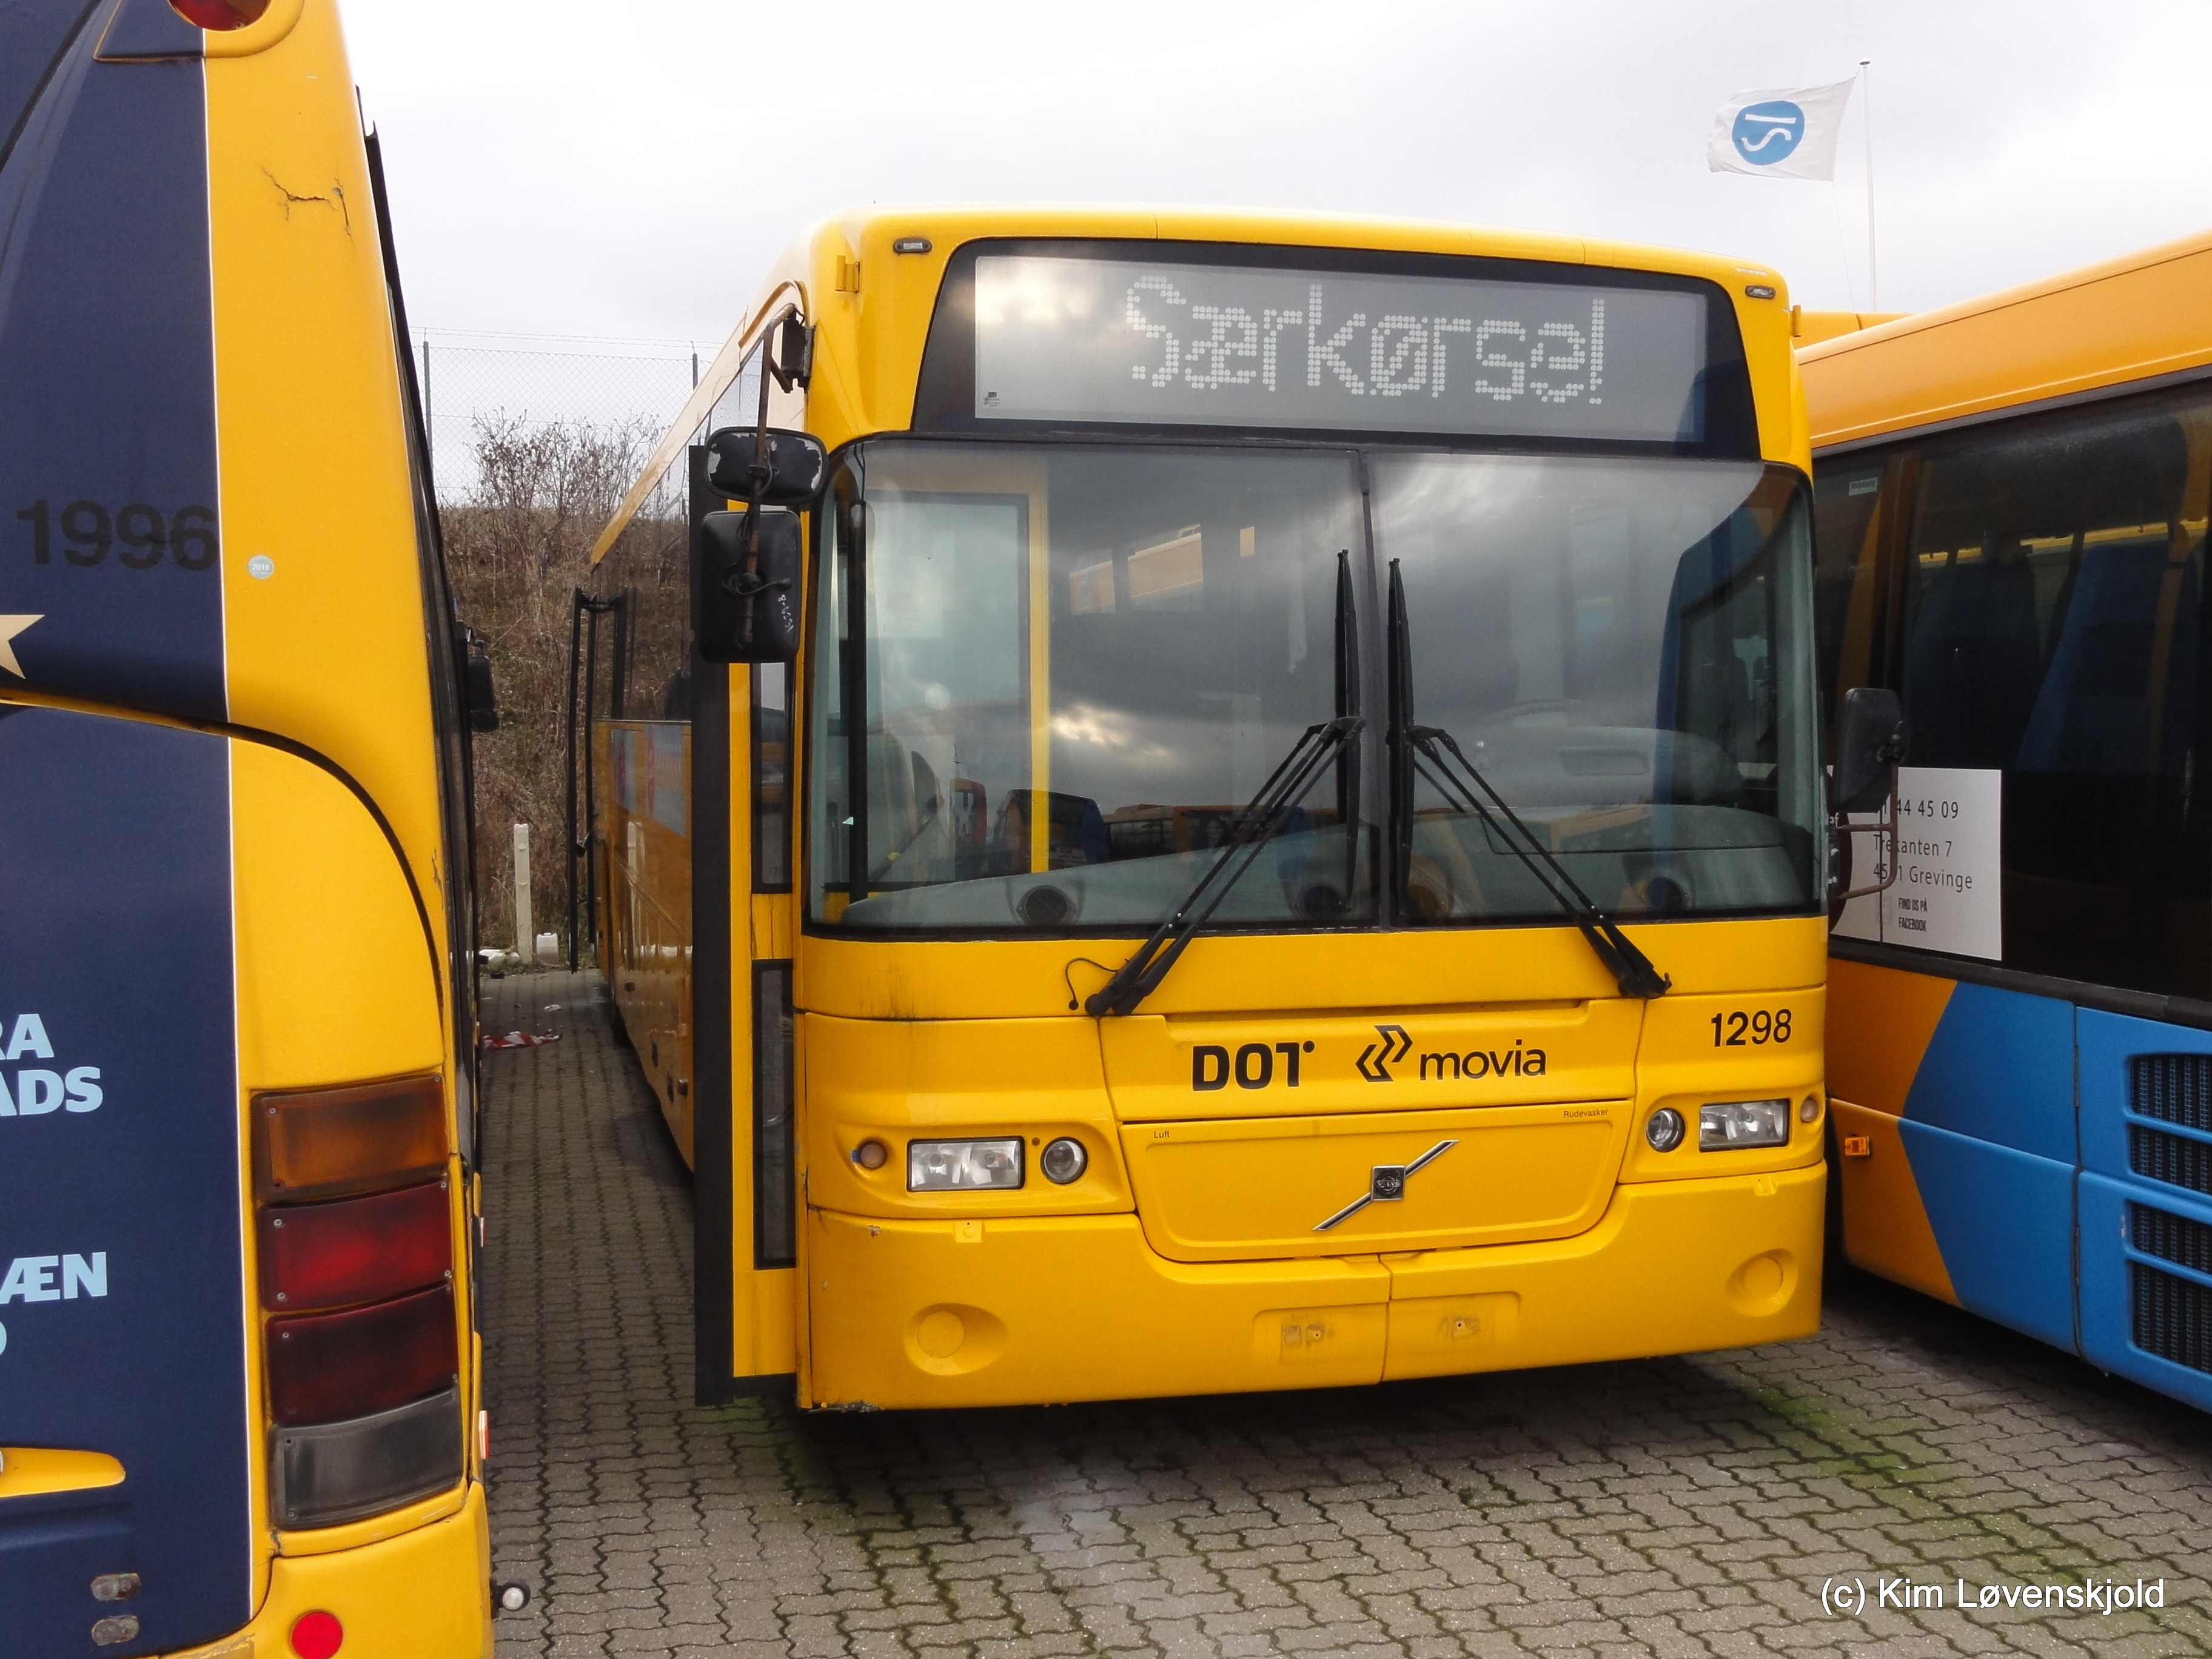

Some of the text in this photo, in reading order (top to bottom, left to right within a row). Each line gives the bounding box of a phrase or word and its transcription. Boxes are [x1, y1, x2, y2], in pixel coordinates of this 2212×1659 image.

[1126, 275, 1606, 405] Særkørsel
[16, 498, 219, 571] 1996
[1918, 800, 1934, 817] 45
[1942, 801, 1959, 819] 09
[1945, 841, 1952, 857] 7
[1873, 863, 1973, 893] 451 Grevinge
[1898, 897, 1928, 912] FIND OS PÅ
[1898, 916, 1927, 932] FACEBOOK
[1711, 1008, 1792, 1047] 1298
[1192, 1041, 1315, 1091] DOT
[1419, 1039, 1547, 1081] movia
[1563, 1108, 1609, 1119] Rudevasker
[1154, 1130, 1170, 1139] Luft
[1376, 1179, 1401, 1188] VLVO
